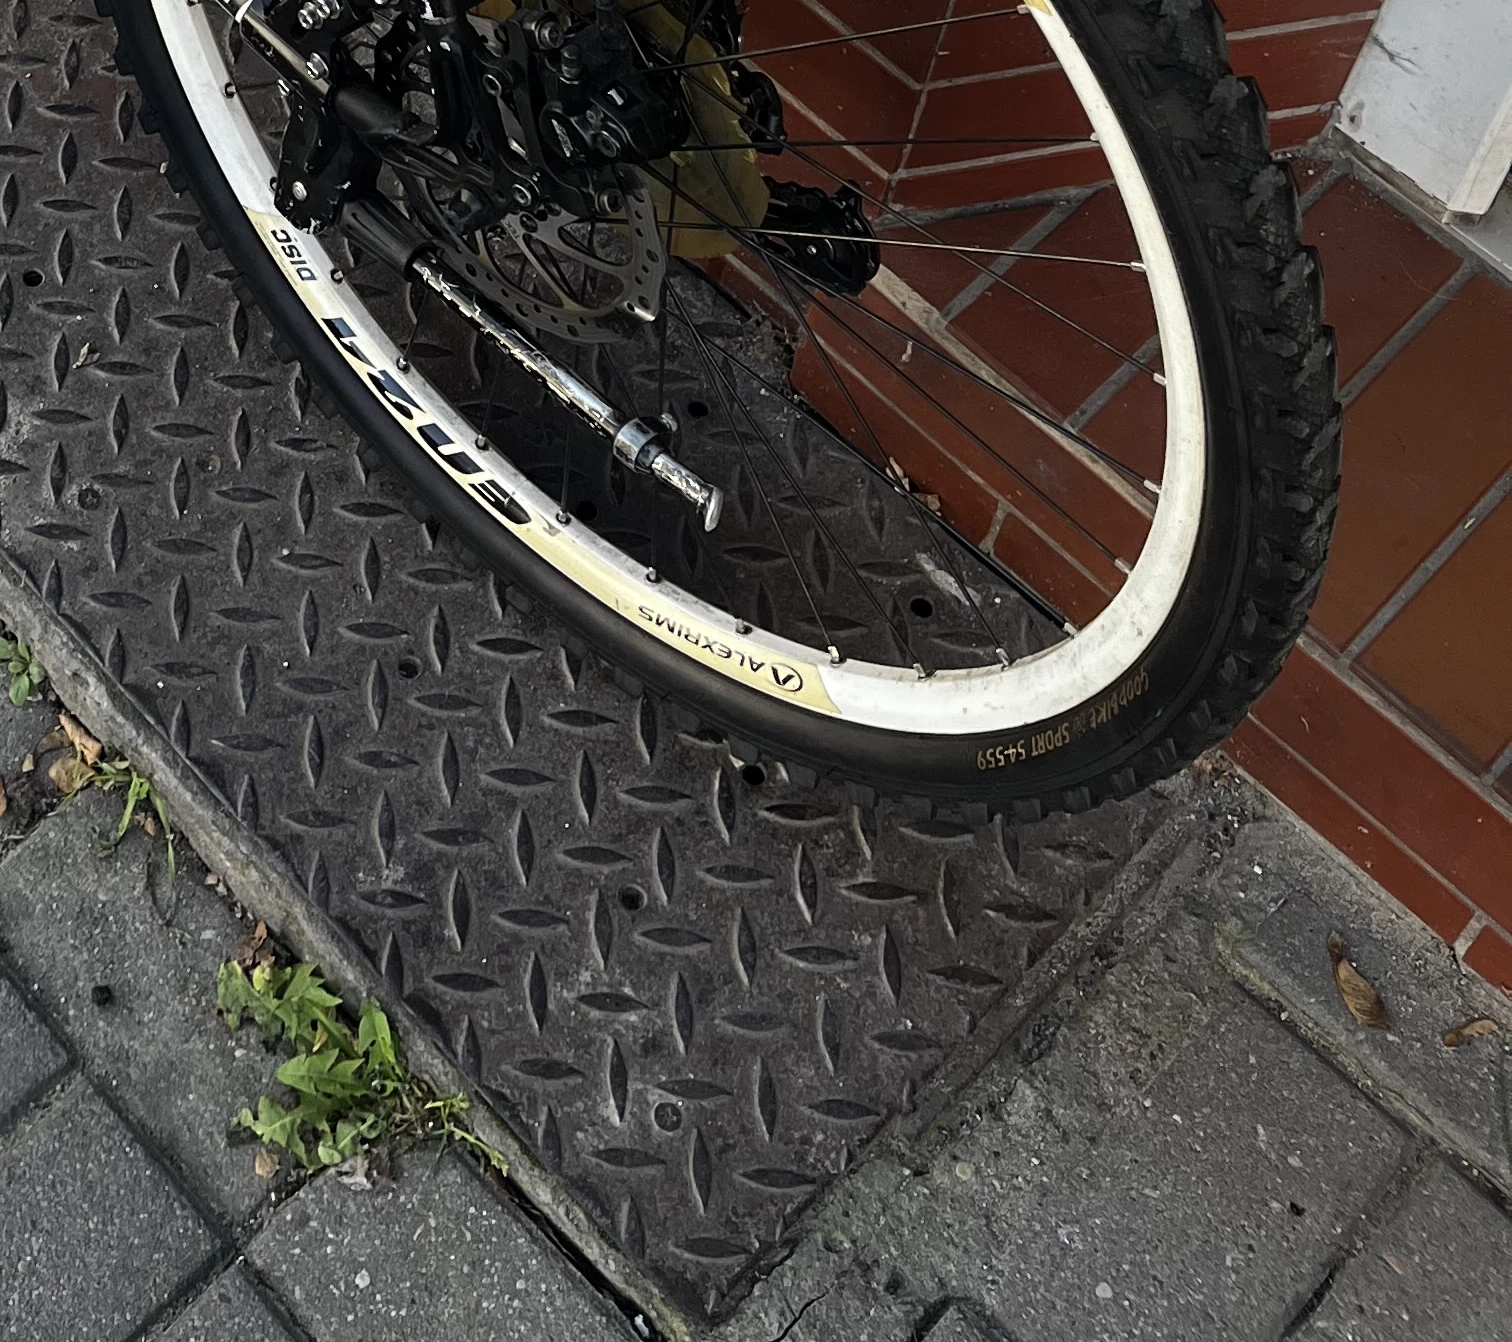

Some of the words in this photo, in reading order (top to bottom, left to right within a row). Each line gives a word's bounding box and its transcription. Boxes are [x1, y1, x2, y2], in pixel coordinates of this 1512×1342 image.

[270, 228, 319, 282] DISC
[638, 605, 767, 672] ALEXRIMS
[1030, 722, 1070, 758] SPORT
